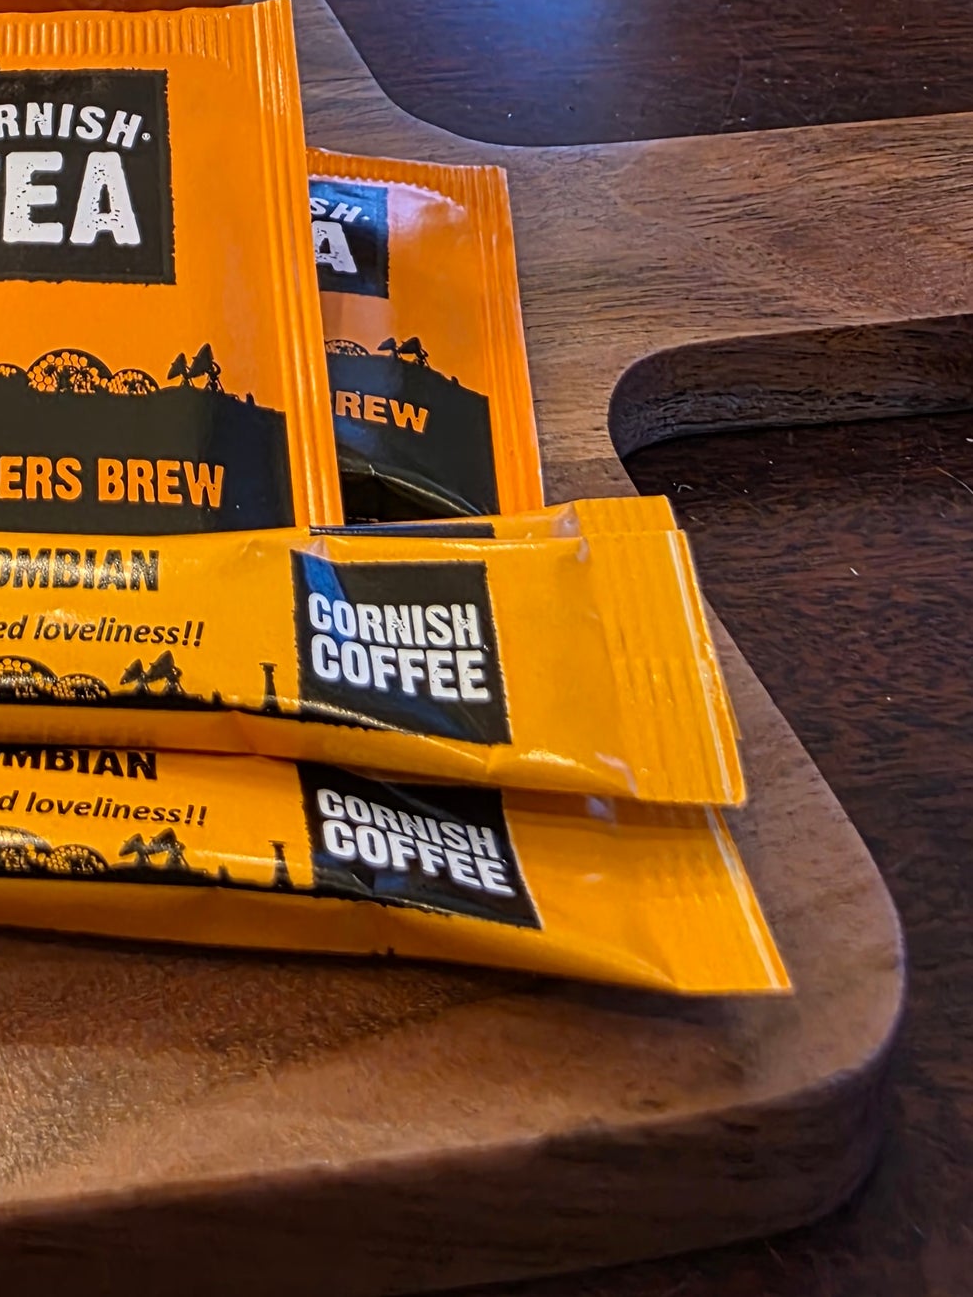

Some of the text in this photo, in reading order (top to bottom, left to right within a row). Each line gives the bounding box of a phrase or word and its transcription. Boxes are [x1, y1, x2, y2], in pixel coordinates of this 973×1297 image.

[335, 390, 429, 434] REW
[98, 457, 226, 508] BREW
[34, 614, 204, 647] loveliness!!
[307, 592, 481, 647] CORNISH
[311, 633, 490, 701] COFFEE
[25, 790, 208, 826] loveliness!!
[316, 788, 502, 859] CORNISH
[322, 820, 517, 897] COFFEE
